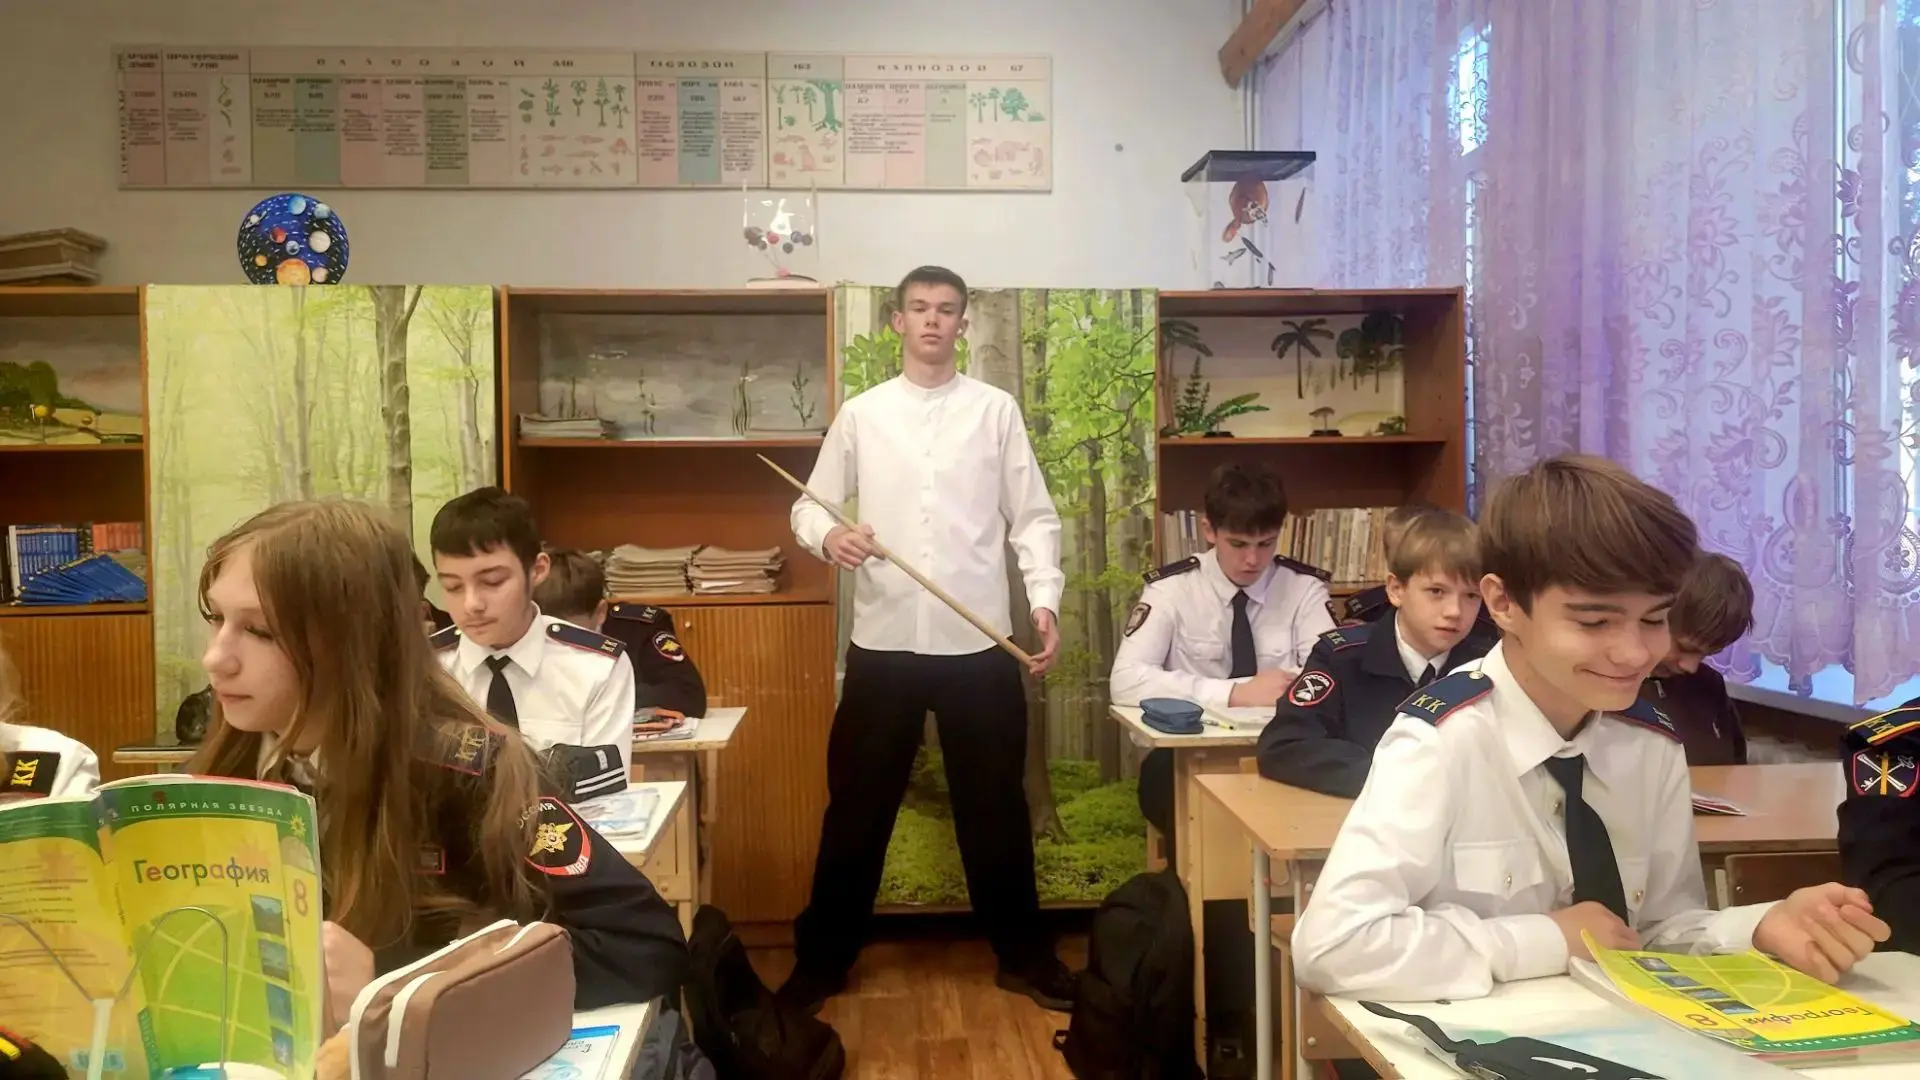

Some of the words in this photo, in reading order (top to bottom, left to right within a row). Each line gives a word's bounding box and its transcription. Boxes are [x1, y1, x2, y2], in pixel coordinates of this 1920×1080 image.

[1411, 694, 1447, 714] КК
[10, 759, 39, 787] КК
[133, 856, 270, 888] География
[293, 878, 309, 918] 8
[1684, 1013, 1719, 1026] 8
[1742, 1005, 1874, 1025] География
